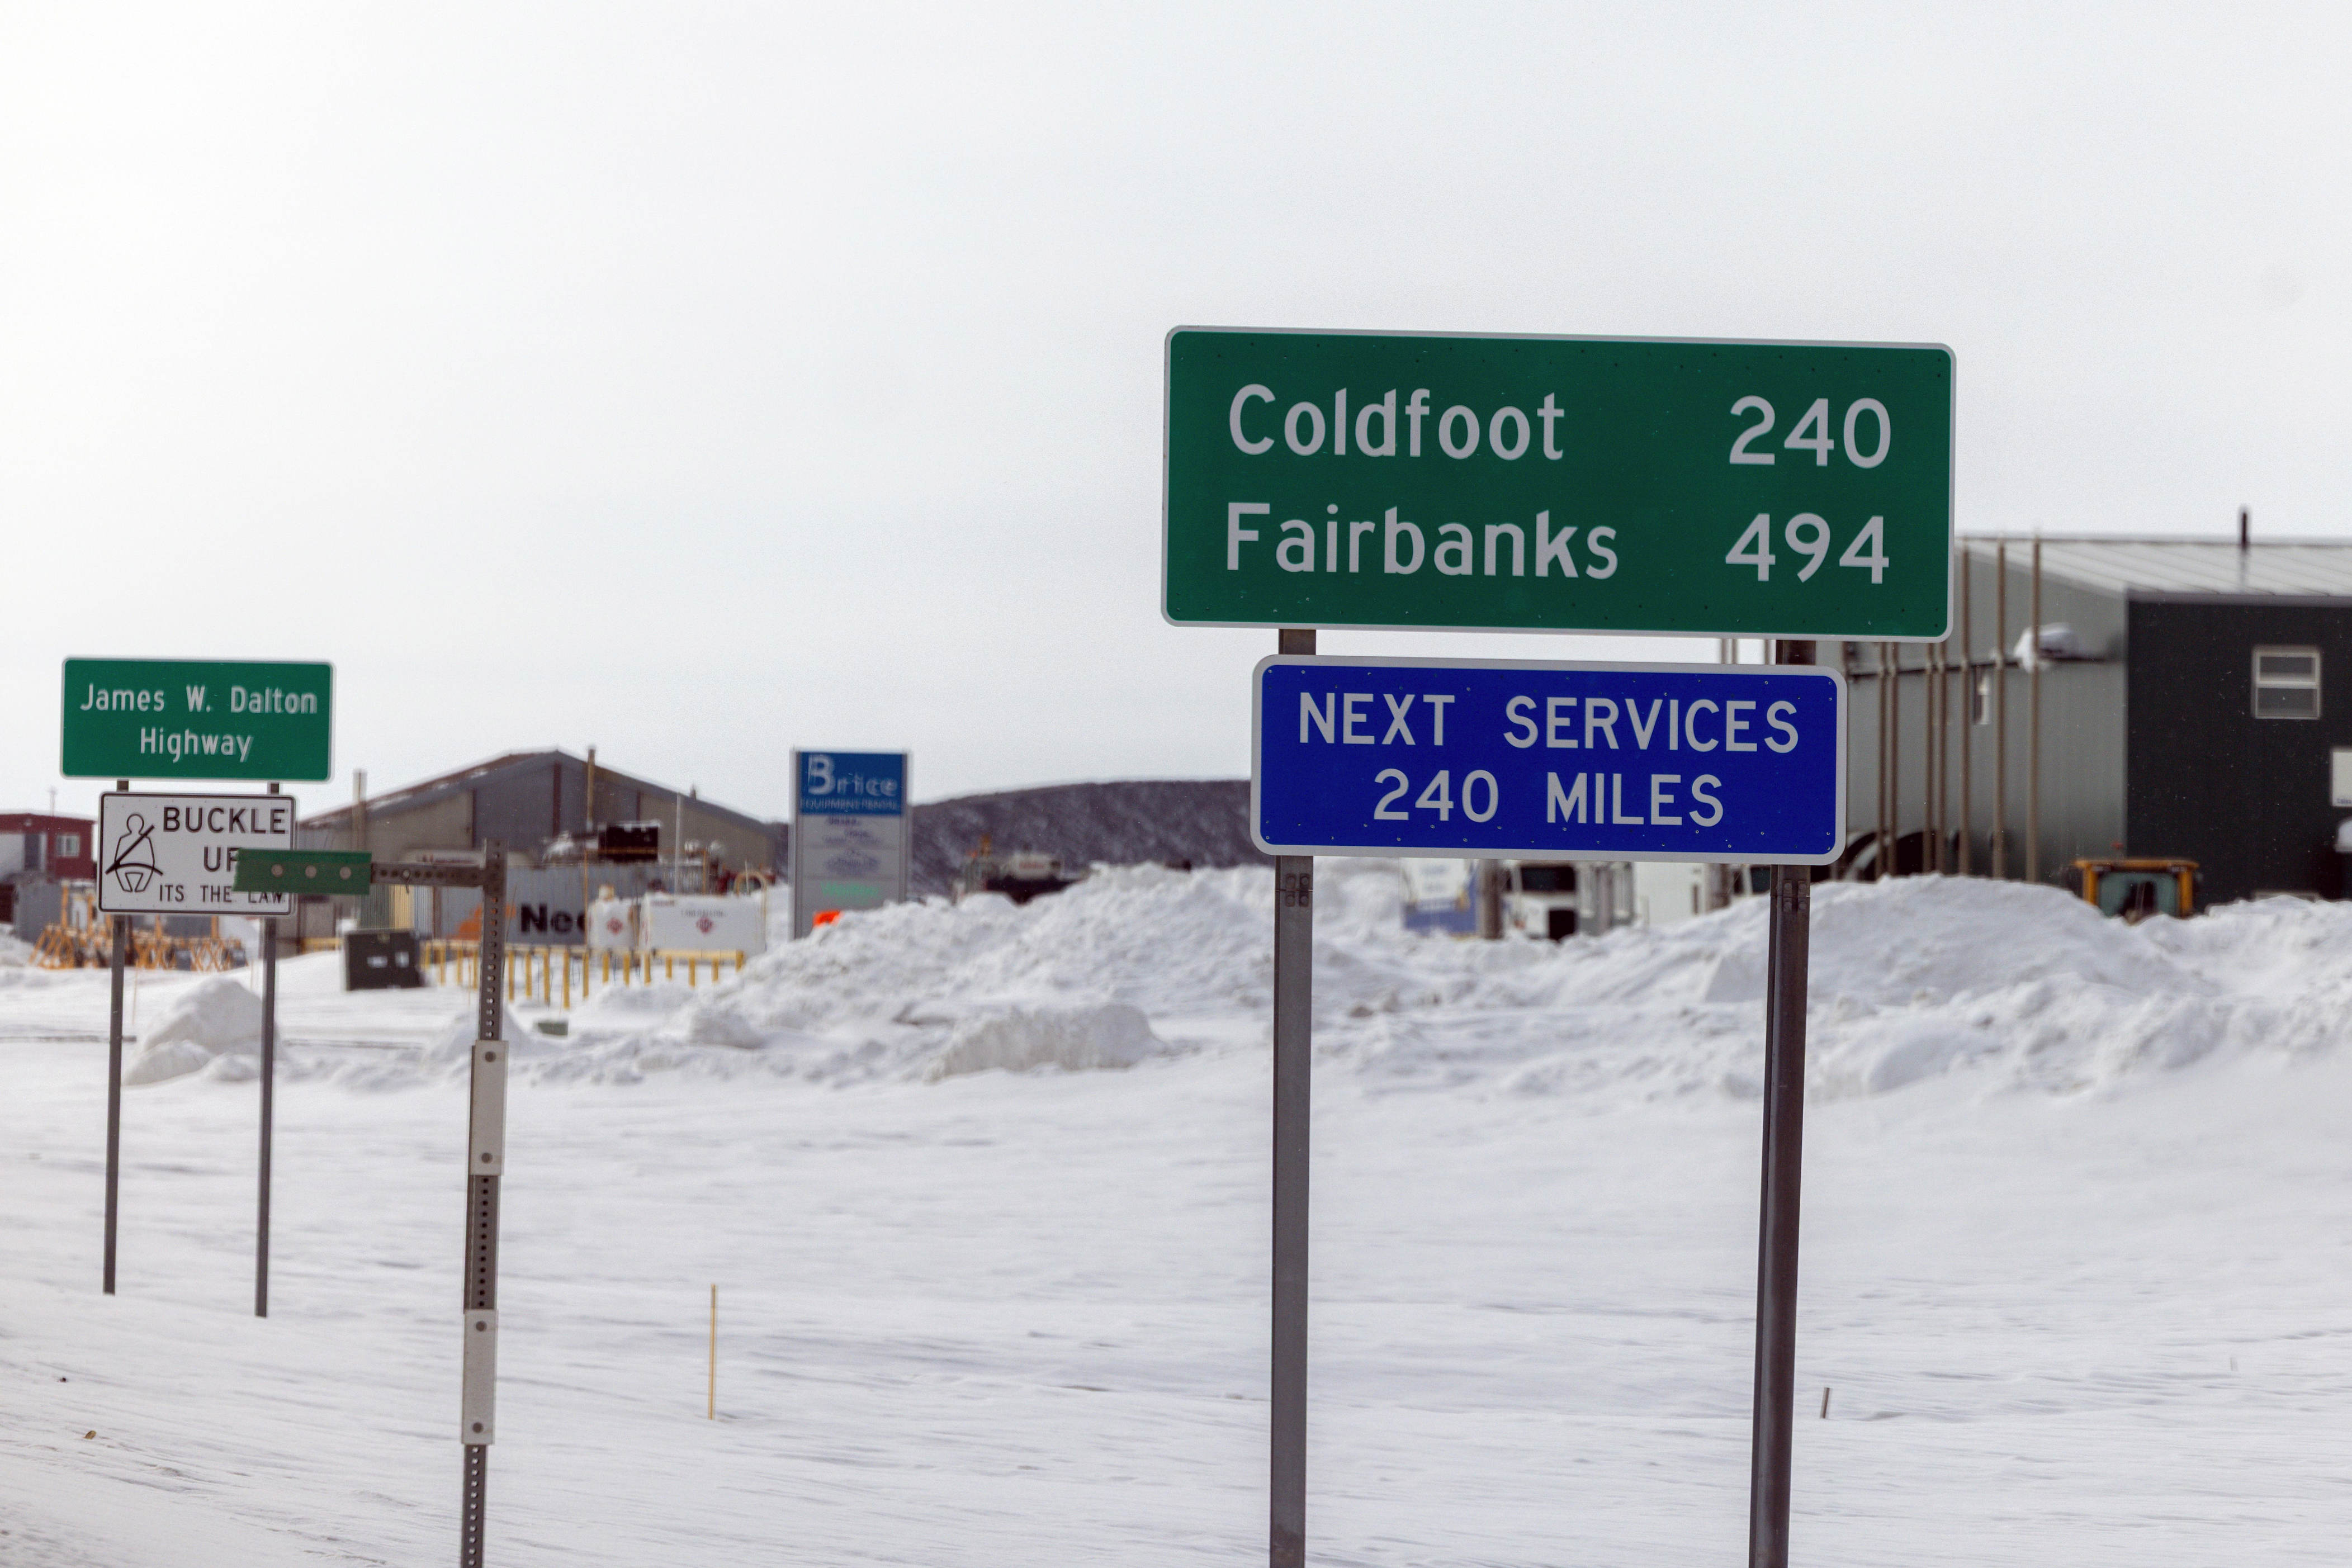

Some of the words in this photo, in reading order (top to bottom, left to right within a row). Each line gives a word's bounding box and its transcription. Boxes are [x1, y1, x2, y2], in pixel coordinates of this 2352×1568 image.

[1229, 384, 1565, 459] Coldfoot
[1729, 395, 1891, 468] 240
[1227, 503, 1618, 579] Fairbanks
[1725, 513, 1890, 584] 494
[80, 683, 165, 712] James
[186, 685, 212, 712] W.
[230, 685, 318, 714] Dalton
[1300, 692, 1455, 746] NEXT
[1504, 695, 1799, 753] SERVICES
[140, 727, 253, 763] Highway
[808, 755, 898, 797] Brice
[1374, 768, 1498, 823] 240
[1547, 772, 1723, 827] MILES
[163, 806, 287, 835] BUCKLE
[159, 884, 184, 902] ITS
[200, 885, 233, 903] THE
